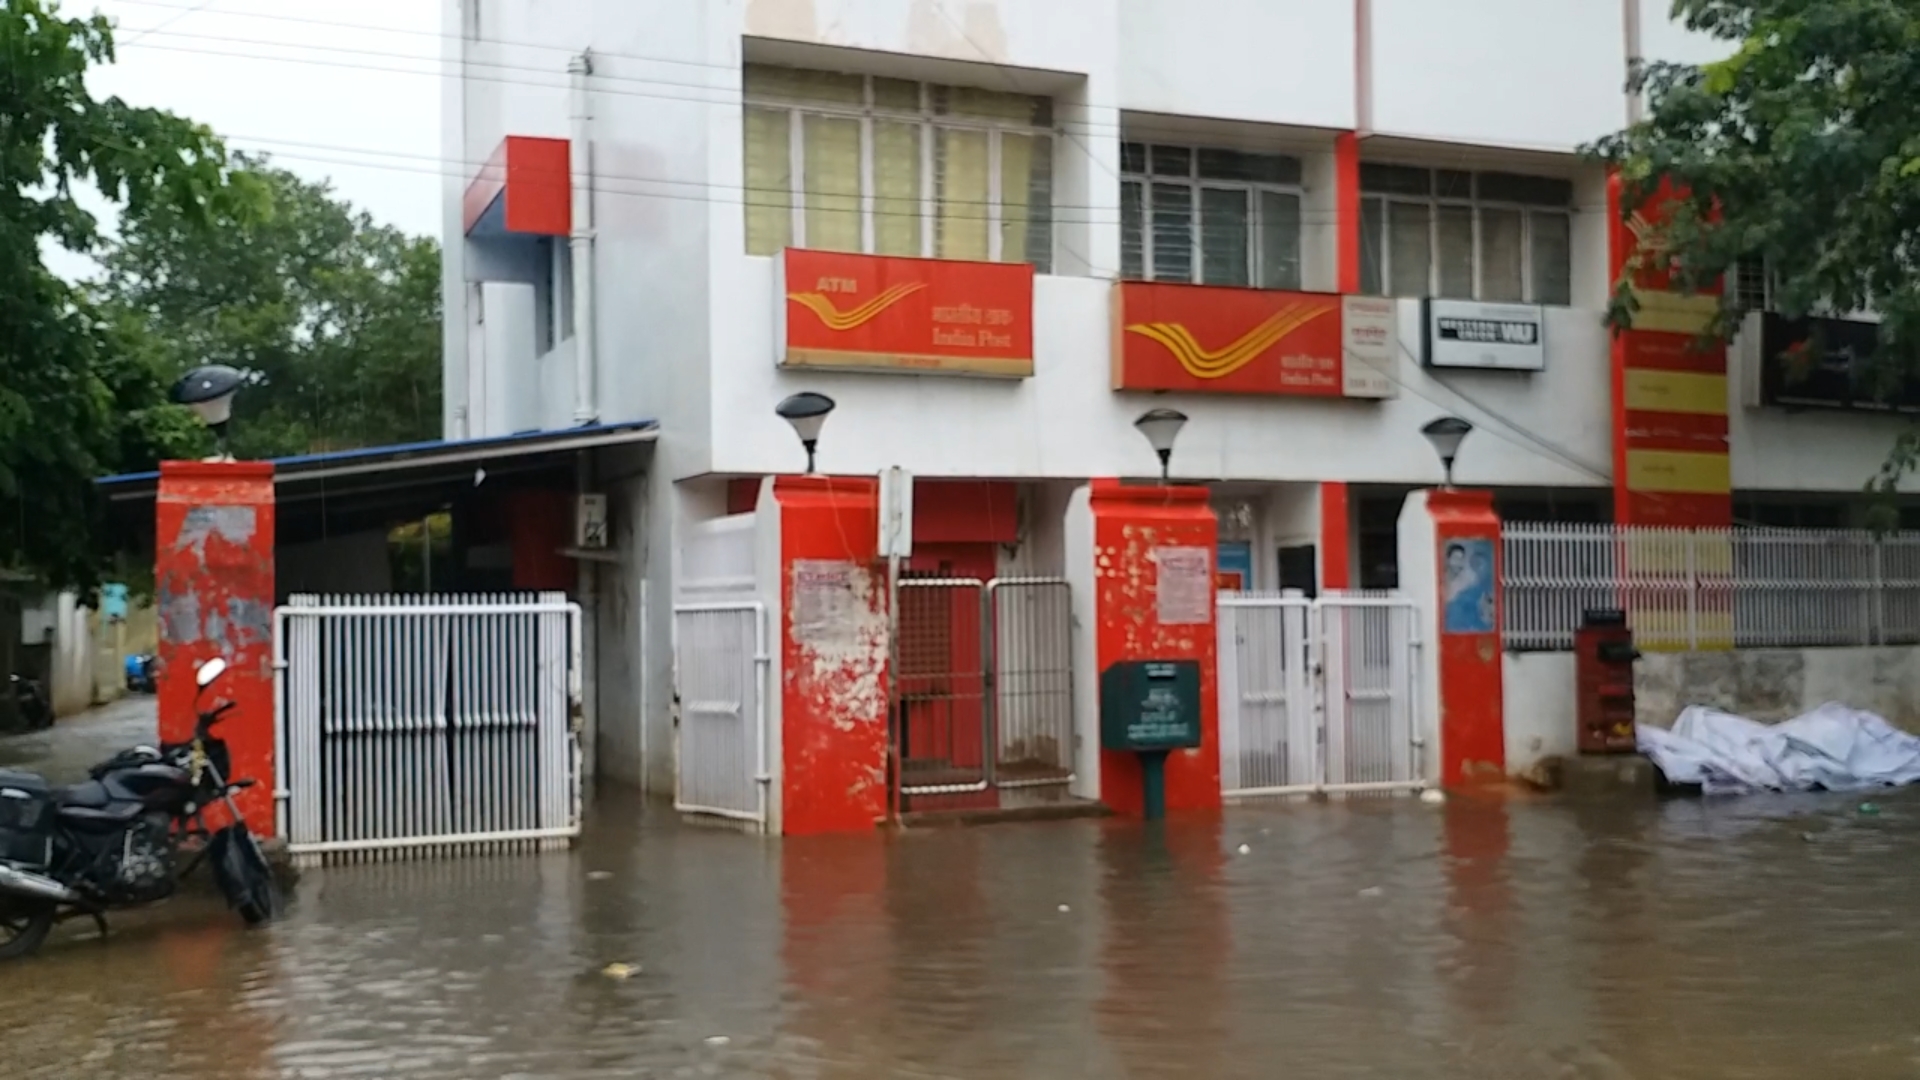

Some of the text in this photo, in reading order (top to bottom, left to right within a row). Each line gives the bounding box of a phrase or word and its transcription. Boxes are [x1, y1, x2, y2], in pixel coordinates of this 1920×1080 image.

[816, 276, 857, 293] ATM
[933, 328, 1011, 347] India Post
[1501, 322, 1534, 343] WU
